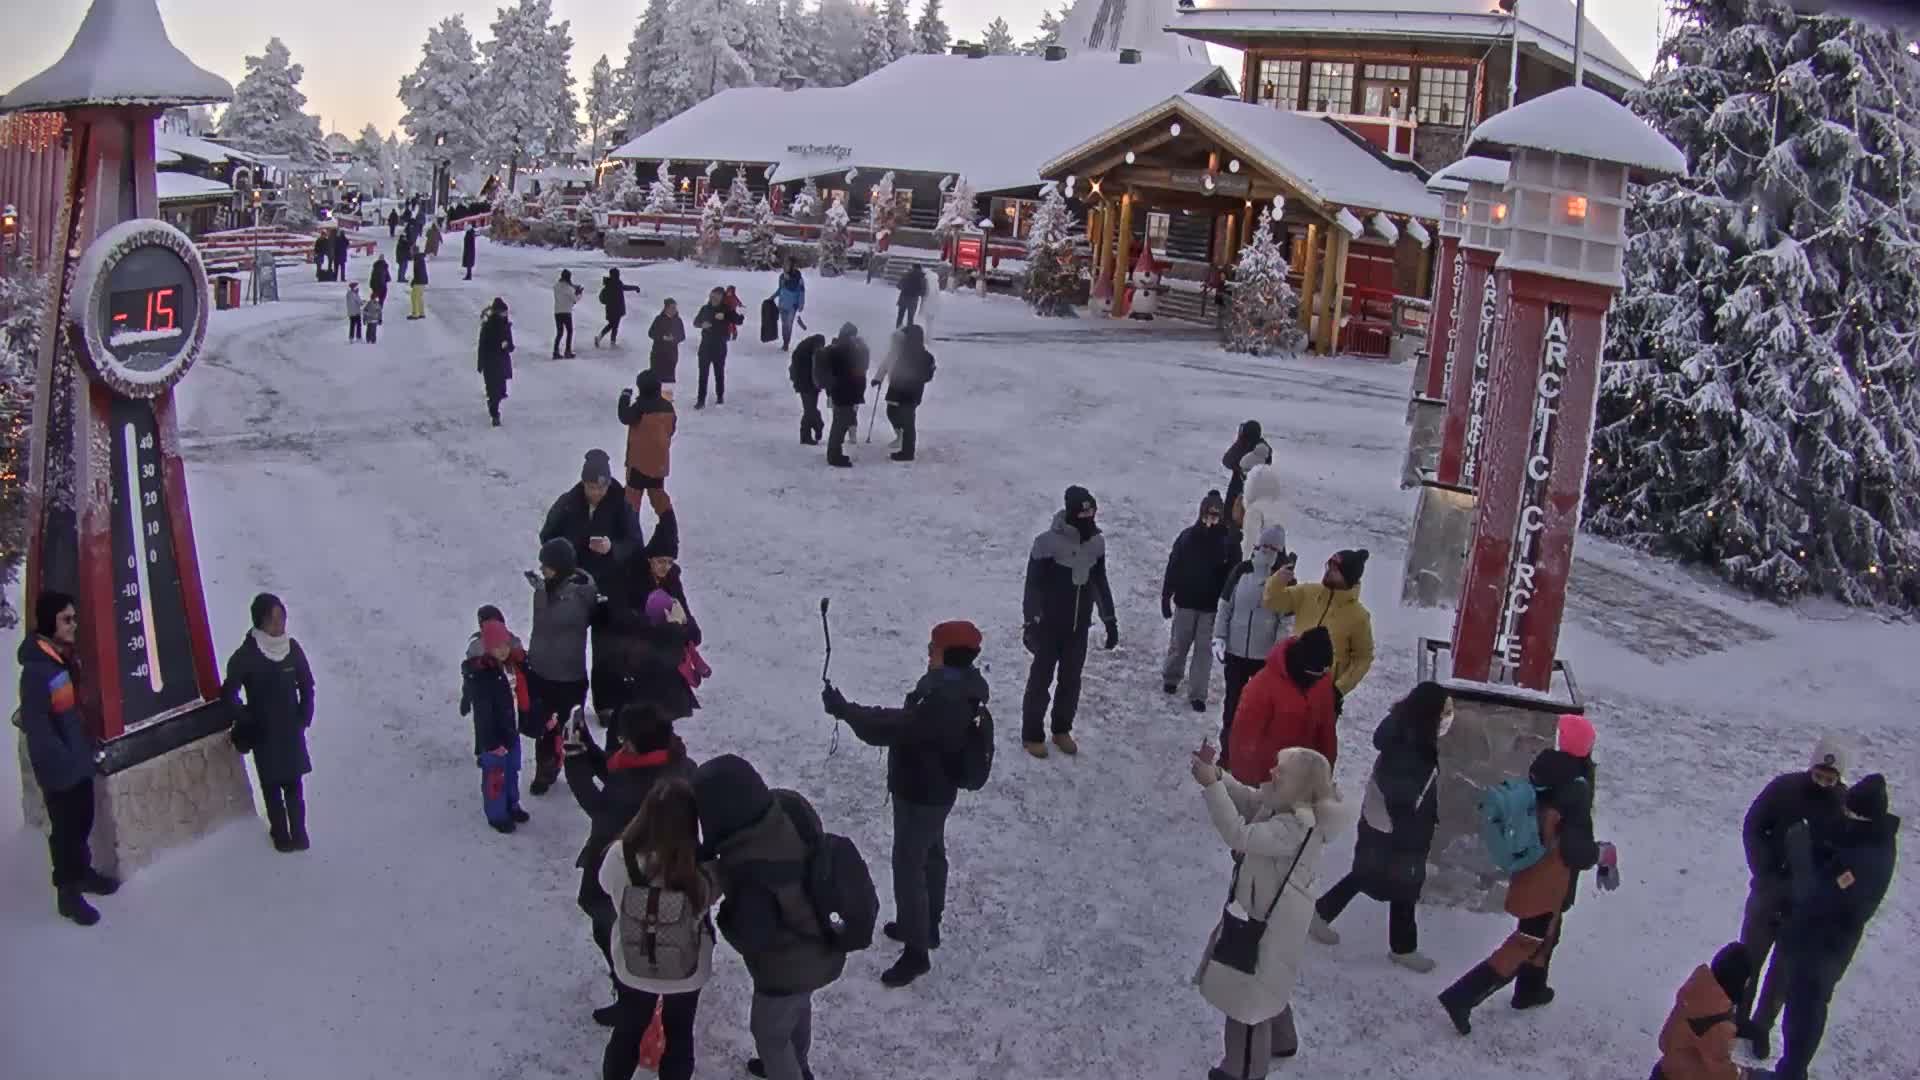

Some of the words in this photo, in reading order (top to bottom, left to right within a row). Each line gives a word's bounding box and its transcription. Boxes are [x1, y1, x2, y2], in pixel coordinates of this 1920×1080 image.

[1450, 252, 1463, 319] ARCTIC
[1475, 273, 1497, 369] ARCTIC
[1528, 316, 1568, 481] ARCTIC
[139, 432, 153, 450] 40
[142, 463, 155, 478] 30
[144, 491, 158, 505] 20
[147, 520, 159, 536] 10
[128, 554, 135, 568] 0
[150, 549, 157, 563] 0
[122, 582, 138, 597] -10
[1500, 505, 1544, 668] CIRCLE
[124, 608, 141, 624] -20
[127, 635, 145, 650] -30
[131, 663, 148, 678] -40
